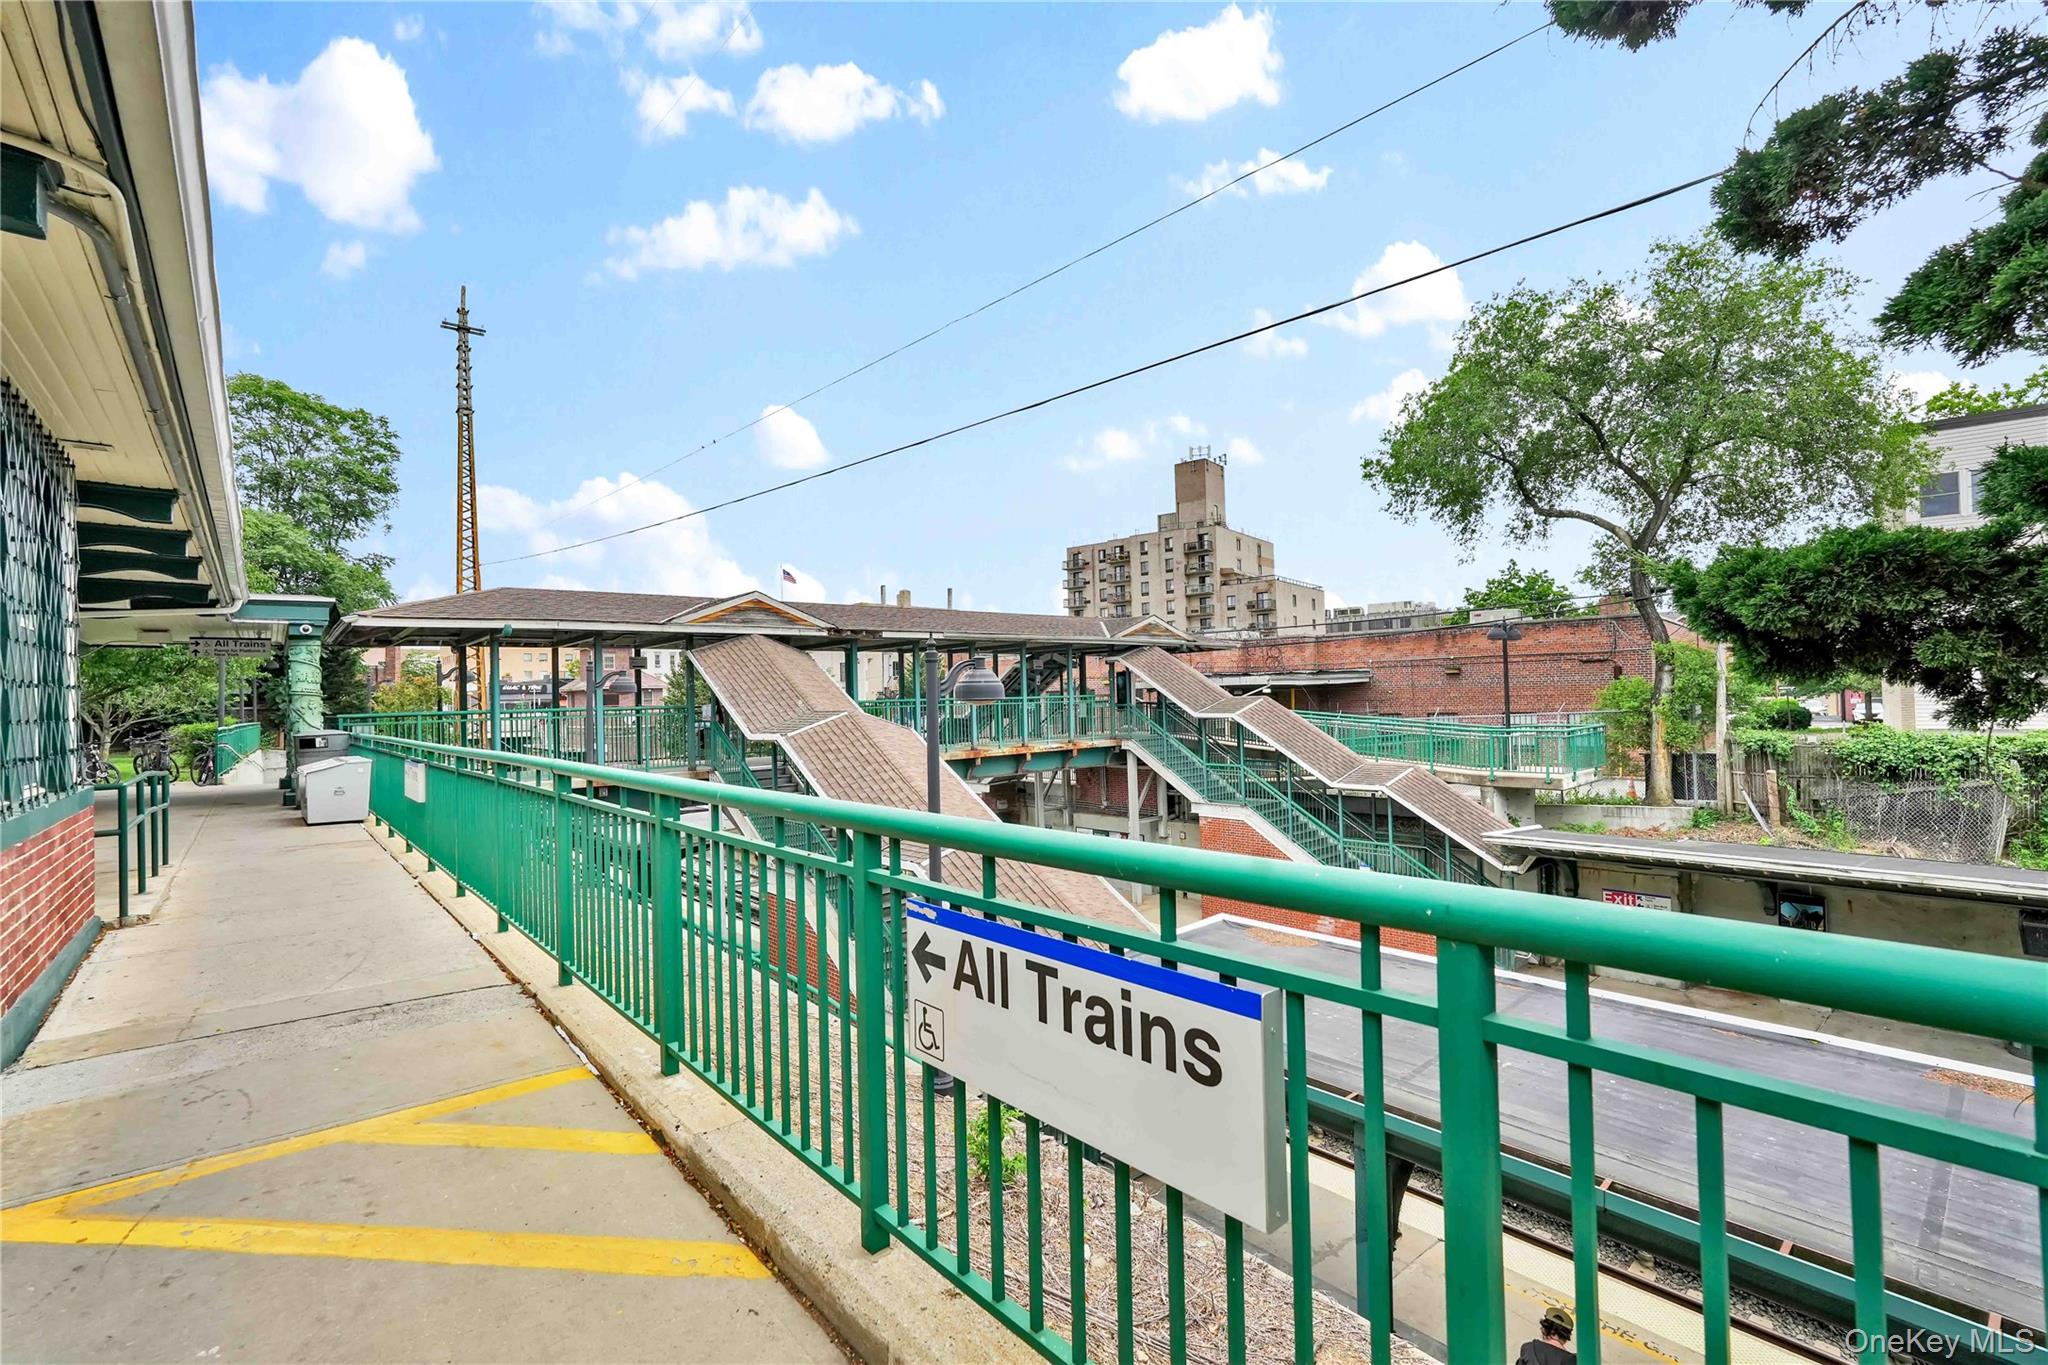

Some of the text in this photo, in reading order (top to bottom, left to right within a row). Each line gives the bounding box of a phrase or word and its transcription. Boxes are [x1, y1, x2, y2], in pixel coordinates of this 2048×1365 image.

[214, 640, 266, 648] All Trains
[1602, 890, 1637, 907] Exit
[953, 939, 1223, 1087] All Trains
